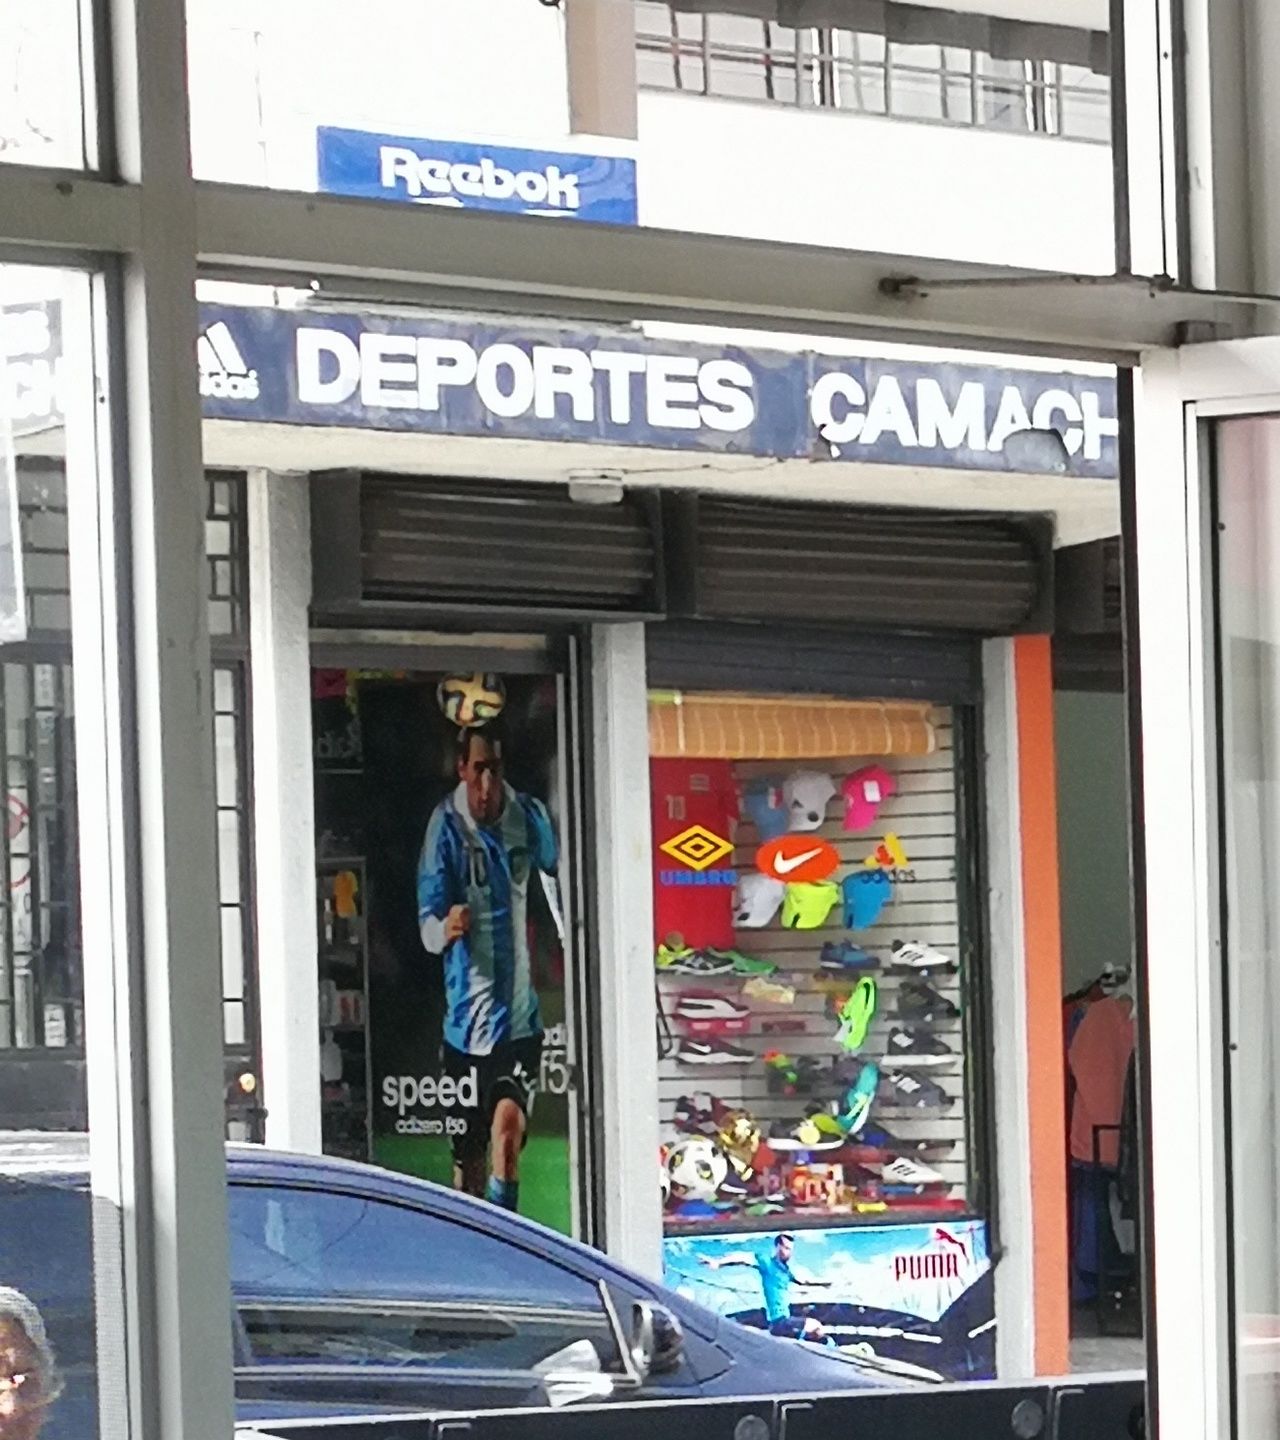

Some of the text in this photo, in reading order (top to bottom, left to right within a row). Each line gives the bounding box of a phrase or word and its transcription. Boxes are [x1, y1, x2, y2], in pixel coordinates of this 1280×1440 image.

[380, 145, 579, 208] Reebok
[296, 327, 755, 433] DEPORTES
[382, 1066, 478, 1116] speed
[895, 1253, 959, 1281] PUMA
